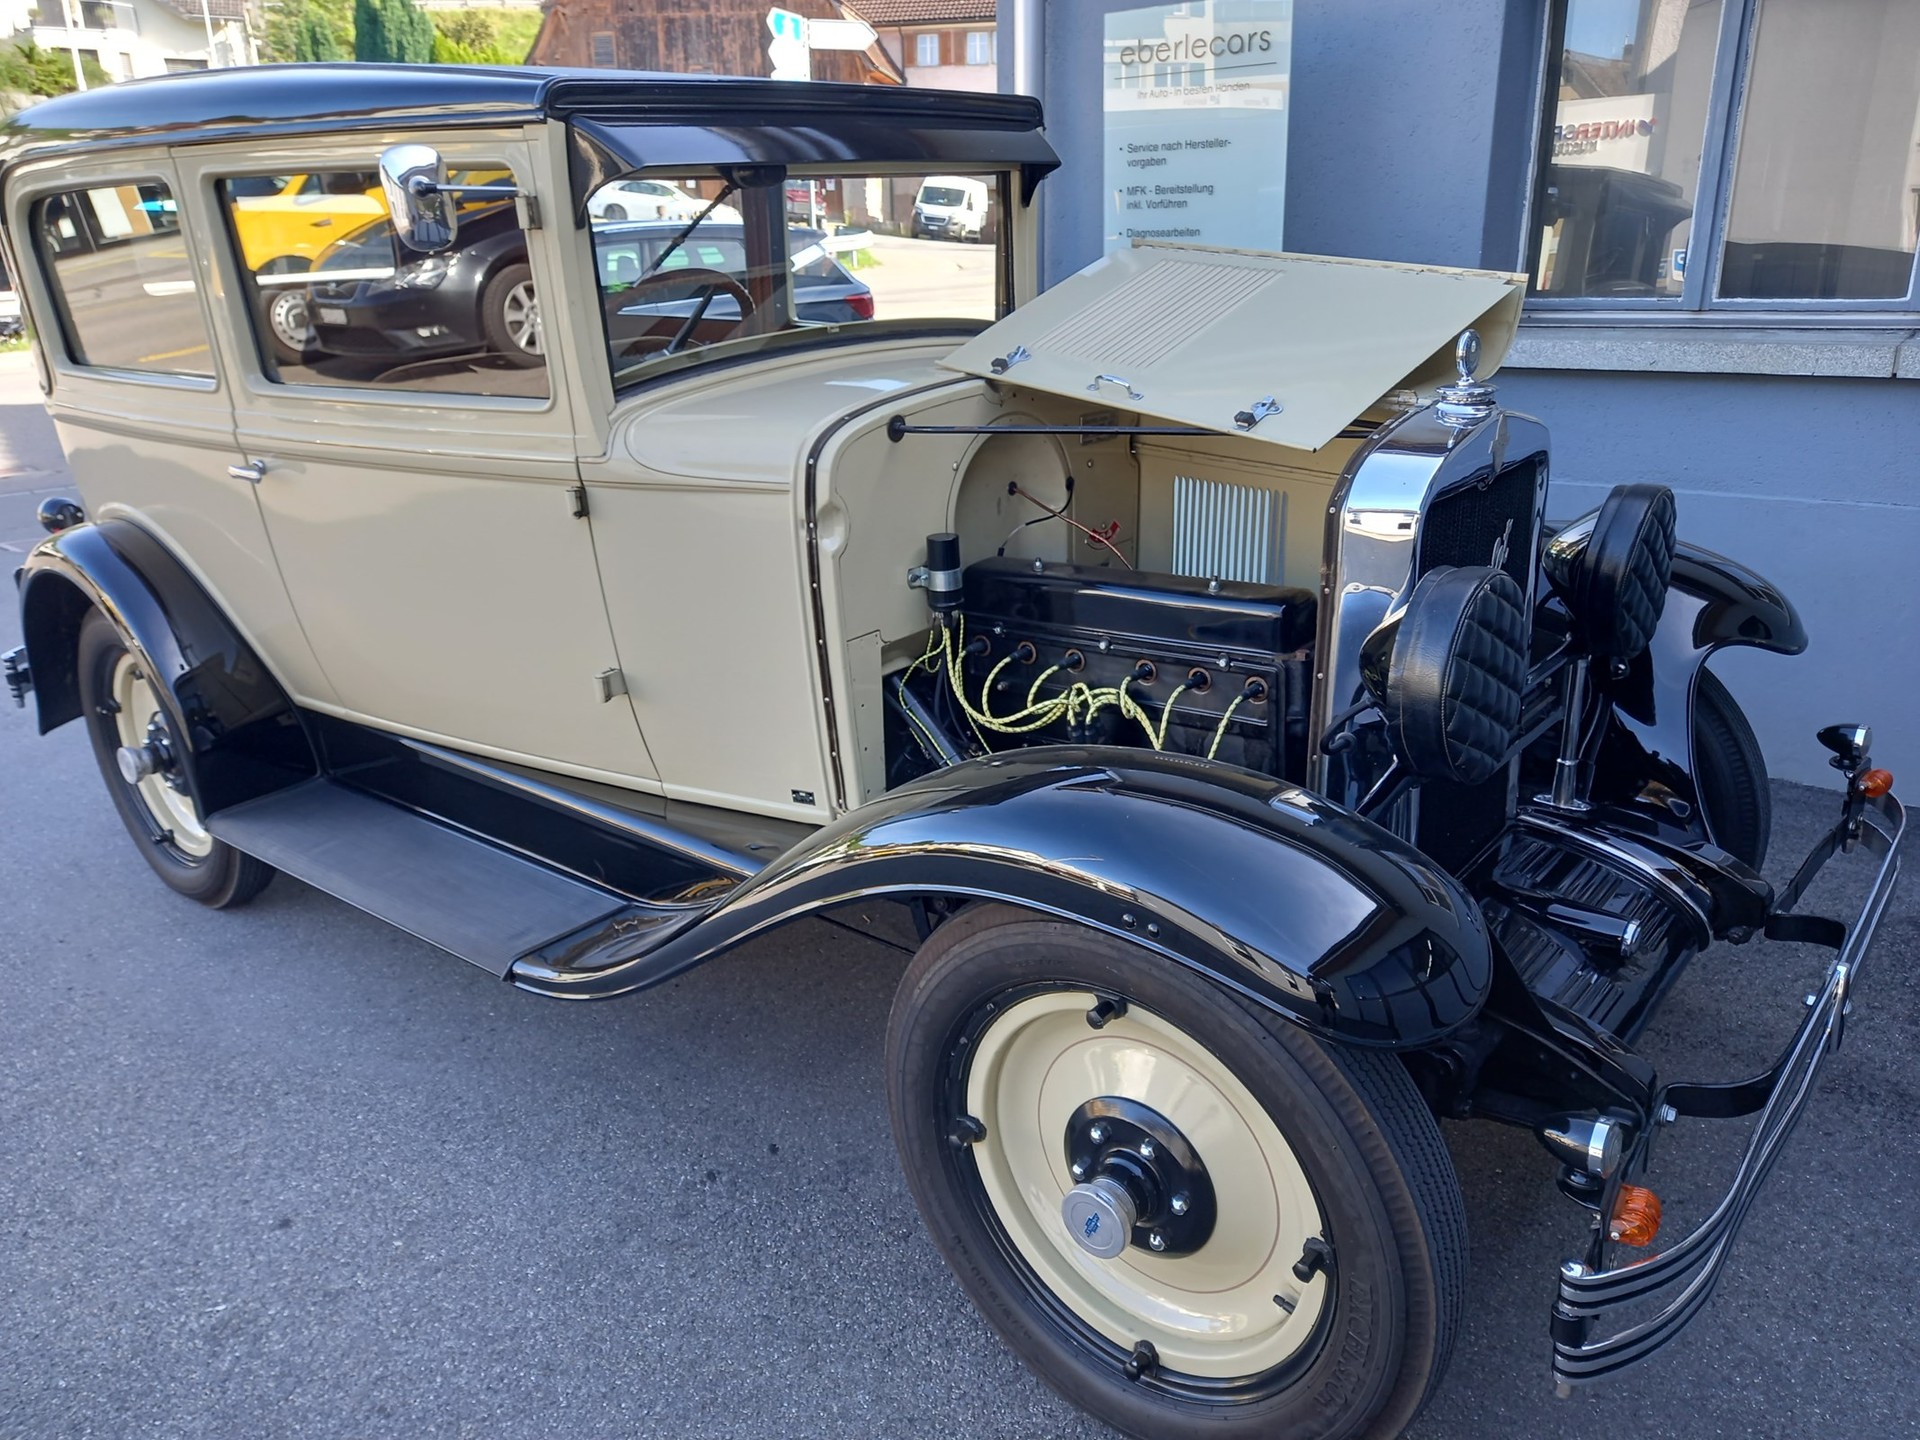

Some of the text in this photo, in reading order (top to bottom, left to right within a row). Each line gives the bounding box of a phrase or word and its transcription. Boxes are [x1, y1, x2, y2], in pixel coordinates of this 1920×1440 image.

[1120, 30, 1271, 66] eberlecars
[1149, 88, 1169, 99] Auto
[1127, 138, 1232, 154] Service nach Hersteller-
[1127, 157, 1167, 169] vorgaben
[1127, 186, 1147, 196] MFK
[1155, 184, 1214, 195] Bereitstellung
[1127, 199, 1188, 210] inkl. Vorführen
[1126, 228, 1200, 239] Diagnosearbeiten
